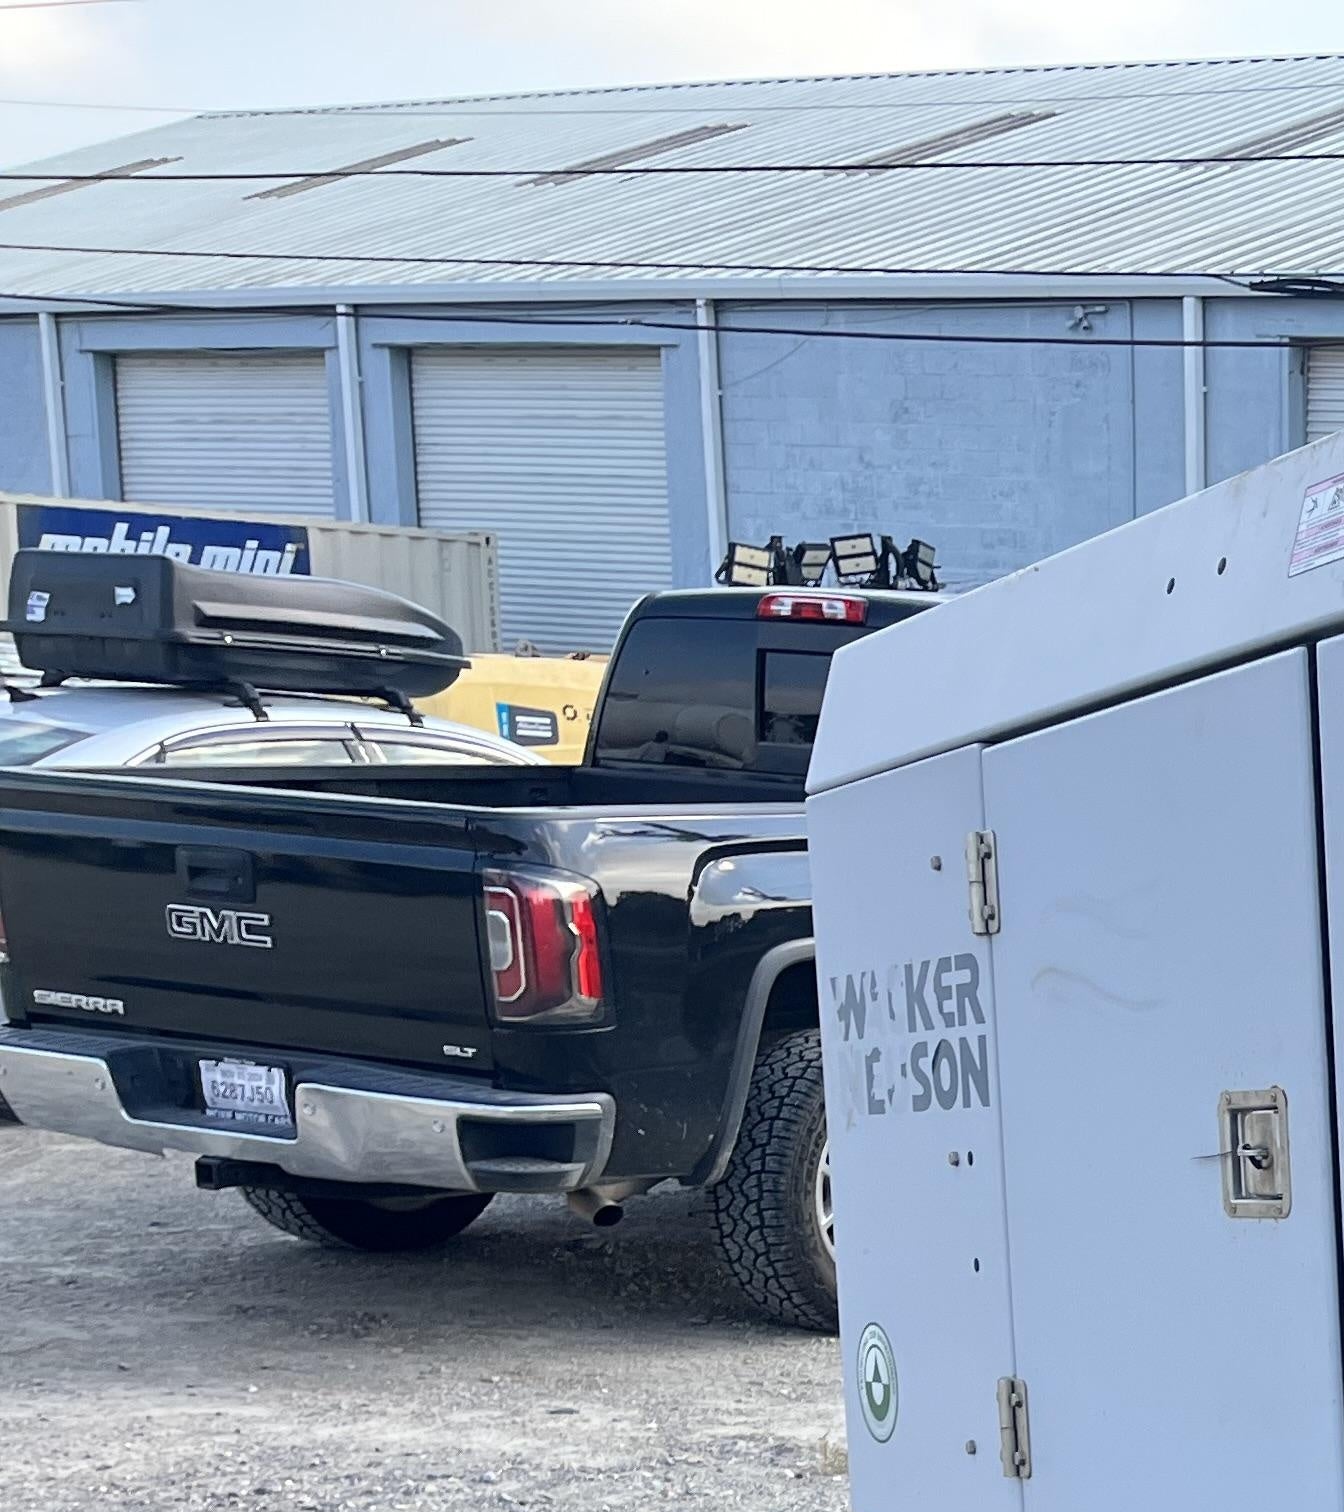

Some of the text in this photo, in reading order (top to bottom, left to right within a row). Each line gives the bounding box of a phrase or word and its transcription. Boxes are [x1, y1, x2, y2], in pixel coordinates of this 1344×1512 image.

[165, 904, 273, 948] GMC
[33, 990, 124, 1015] SIERRA
[830, 953, 986, 1041] WKER
